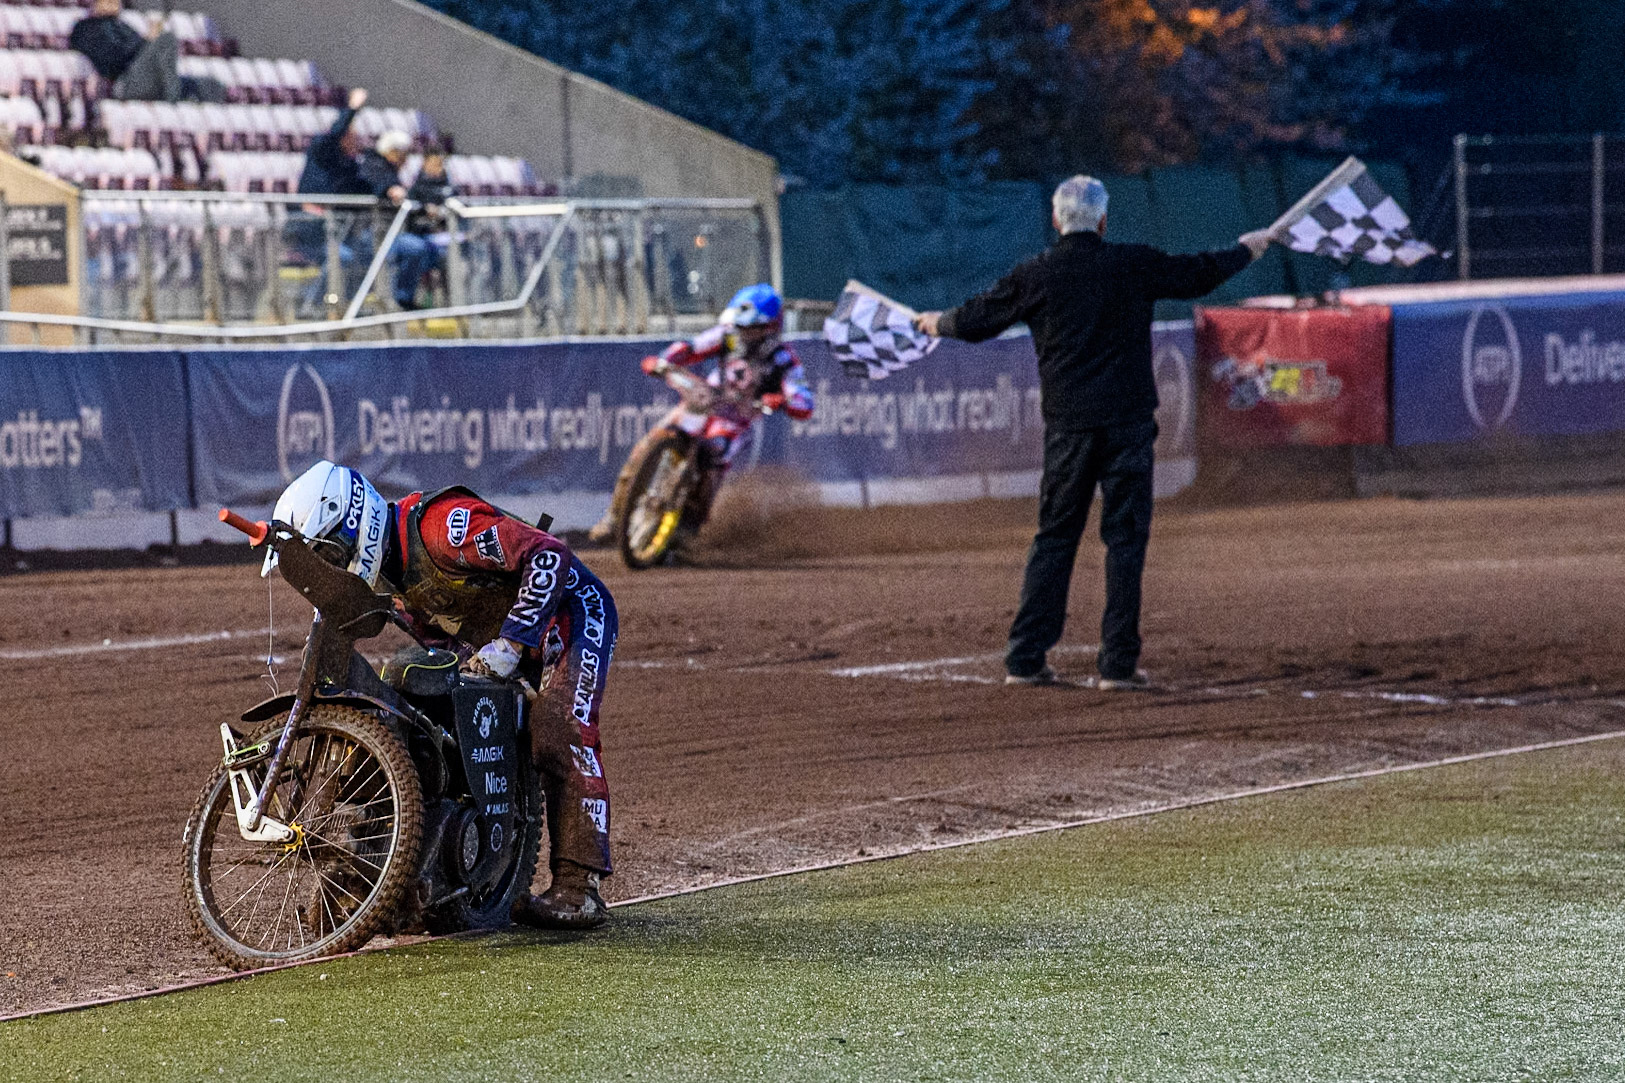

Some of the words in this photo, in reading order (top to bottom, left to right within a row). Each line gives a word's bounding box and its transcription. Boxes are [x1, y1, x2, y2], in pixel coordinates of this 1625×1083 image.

[358, 397, 483, 468] Delivering
[489, 393, 548, 450] what
[551, 393, 615, 464] really
[509, 551, 560, 626] Nice
[485, 772, 508, 796] Nice
